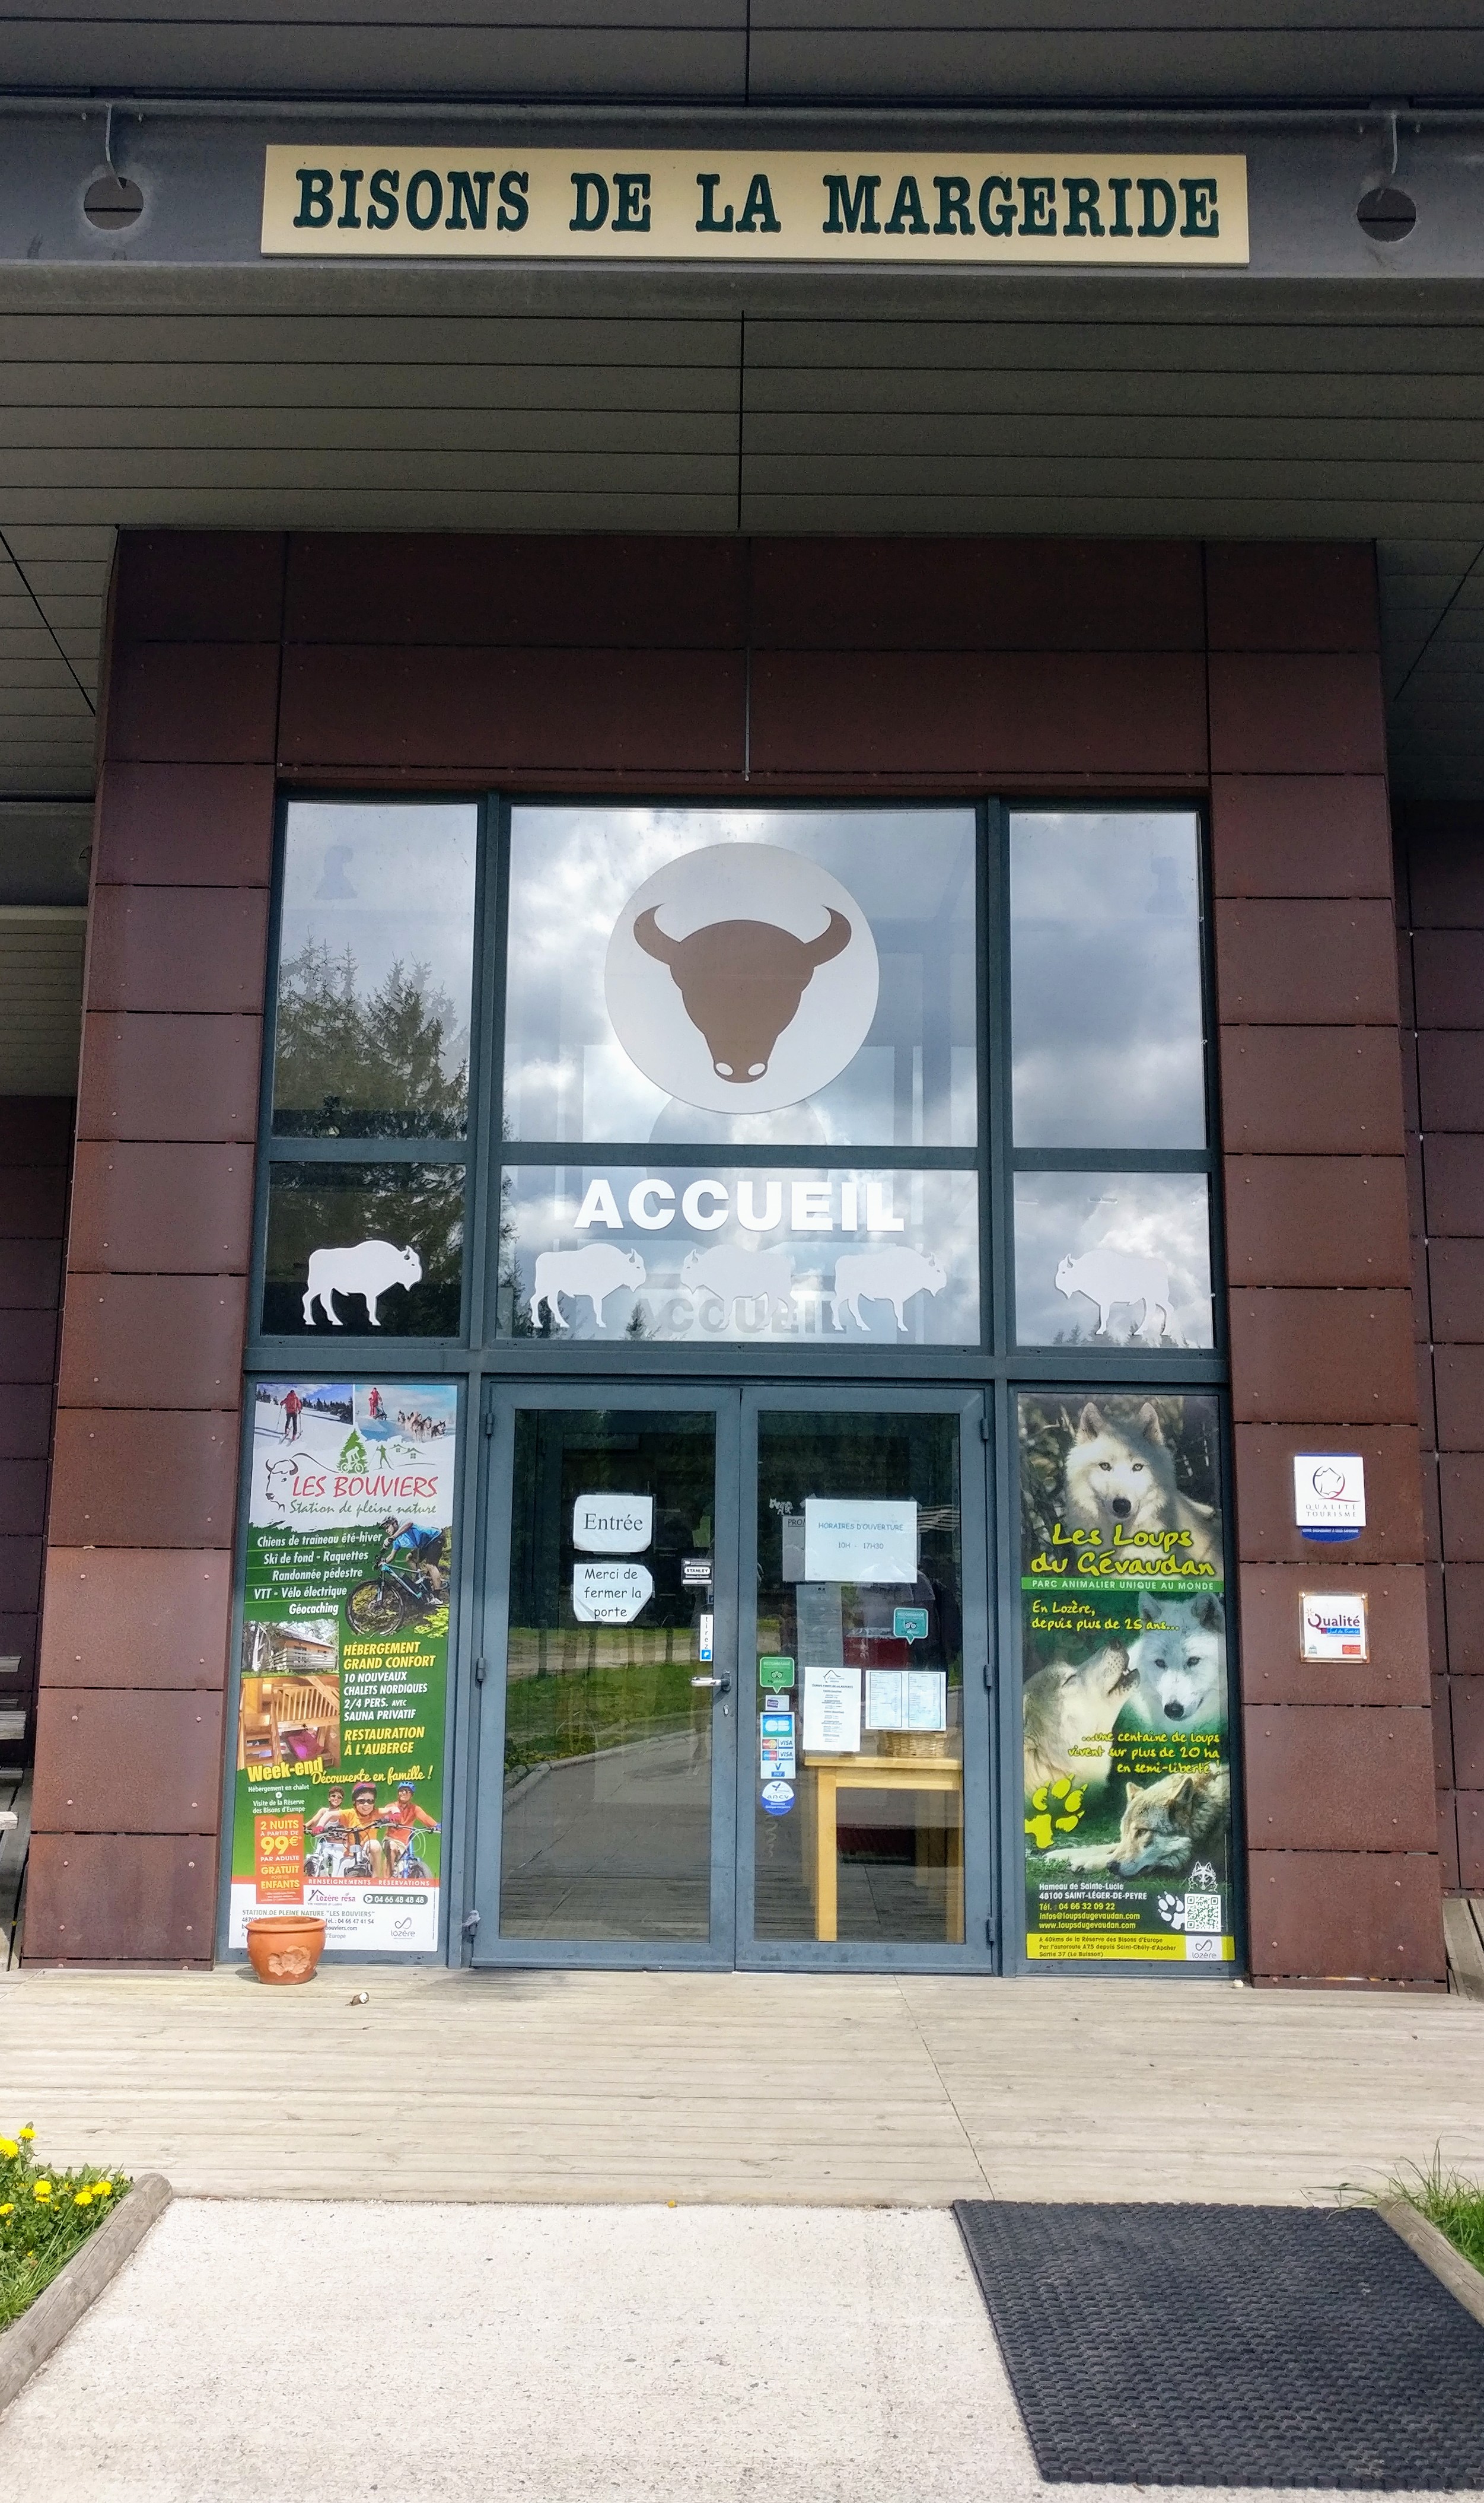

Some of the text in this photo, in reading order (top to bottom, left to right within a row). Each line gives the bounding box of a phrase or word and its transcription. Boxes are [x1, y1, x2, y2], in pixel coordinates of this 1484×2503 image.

[293, 168, 1220, 238] BISONS DE LA MARGERIDE
[574, 1178, 905, 1232] ACCUEIL
[292, 1475, 438, 1499] LES BOUVIERS
[289, 1499, 437, 1518] Station de pleine nature
[583, 1513, 644, 1531] Entrée
[818, 1522, 904, 1531] HORAIRES D'OUVERTURE
[257, 1531, 383, 1547] Chiens de traîneau été-hiver
[1052, 1523, 1193, 1552] Les Loups
[264, 1551, 369, 1564] Ski de fond Raquettes
[1031, 1550, 1216, 1576] du Gévaudan
[272, 1566, 363, 1582] Randonnée pédestre
[584, 1568, 638, 1579] Merci de
[254, 1585, 347, 1599] VTT Vélo électrique
[1032, 1580, 1214, 1591] PARC ANIMALIER UNIQUE AU MONDE
[584, 1586, 642, 1599] fermer la
[289, 1601, 339, 1615] Géocaching
[594, 1607, 628, 1620] porte
[1032, 1599, 1096, 1617] En Lozère,
[1031, 1617, 1072, 1631] depuis
[1077, 1618, 1101, 1631] plus
[1104, 1618, 1121, 1629] de
[1125, 1618, 1142, 1630] 25
[1308, 1613, 1361, 1630] Qualité
[343, 1641, 421, 1656] HÉBERGEMENT
[343, 1655, 436, 1670] GRAND CONFORT
[344, 1671, 407, 1683] 10 NOUVEAUX
[343, 1683, 428, 1696] CHALETS NORDIQUES
[343, 1698, 362, 1710] 2/4
[364, 1697, 388, 1708] PERS.
[343, 1709, 416, 1722] SAUNA PRIVATIF
[344, 1726, 425, 1741] RESTAURATION
[1117, 1731, 1168, 1742] centaine
[1171, 1731, 1187, 1742] de
[344, 1741, 414, 1755] À L'AUBERGE
[1068, 1745, 1220, 1760] vivent sur plus de 20 ha
[247, 1757, 323, 1782] Week-end
[1116, 1761, 1211, 1774] en semi-liberté
[311, 1764, 425, 1785] Découverte en famille
[248, 1785, 284, 1793] Hébergement
[260, 1820, 299, 1830] 2 NUITS
[261, 1865, 300, 1875] GRATUIT
[261, 1879, 300, 1890] ENFANTS
[341, 1893, 356, 1902] résa
[1064, 1891, 1147, 1900] SAINT-LÉGER-DE-PEYRE
[1039, 1903, 1052, 1911] Tél.
[1039, 1912, 1141, 1922] infos@loupsdugevaudan.com
[1039, 1922, 1136, 1930] www.loupsdugevaudan.com
